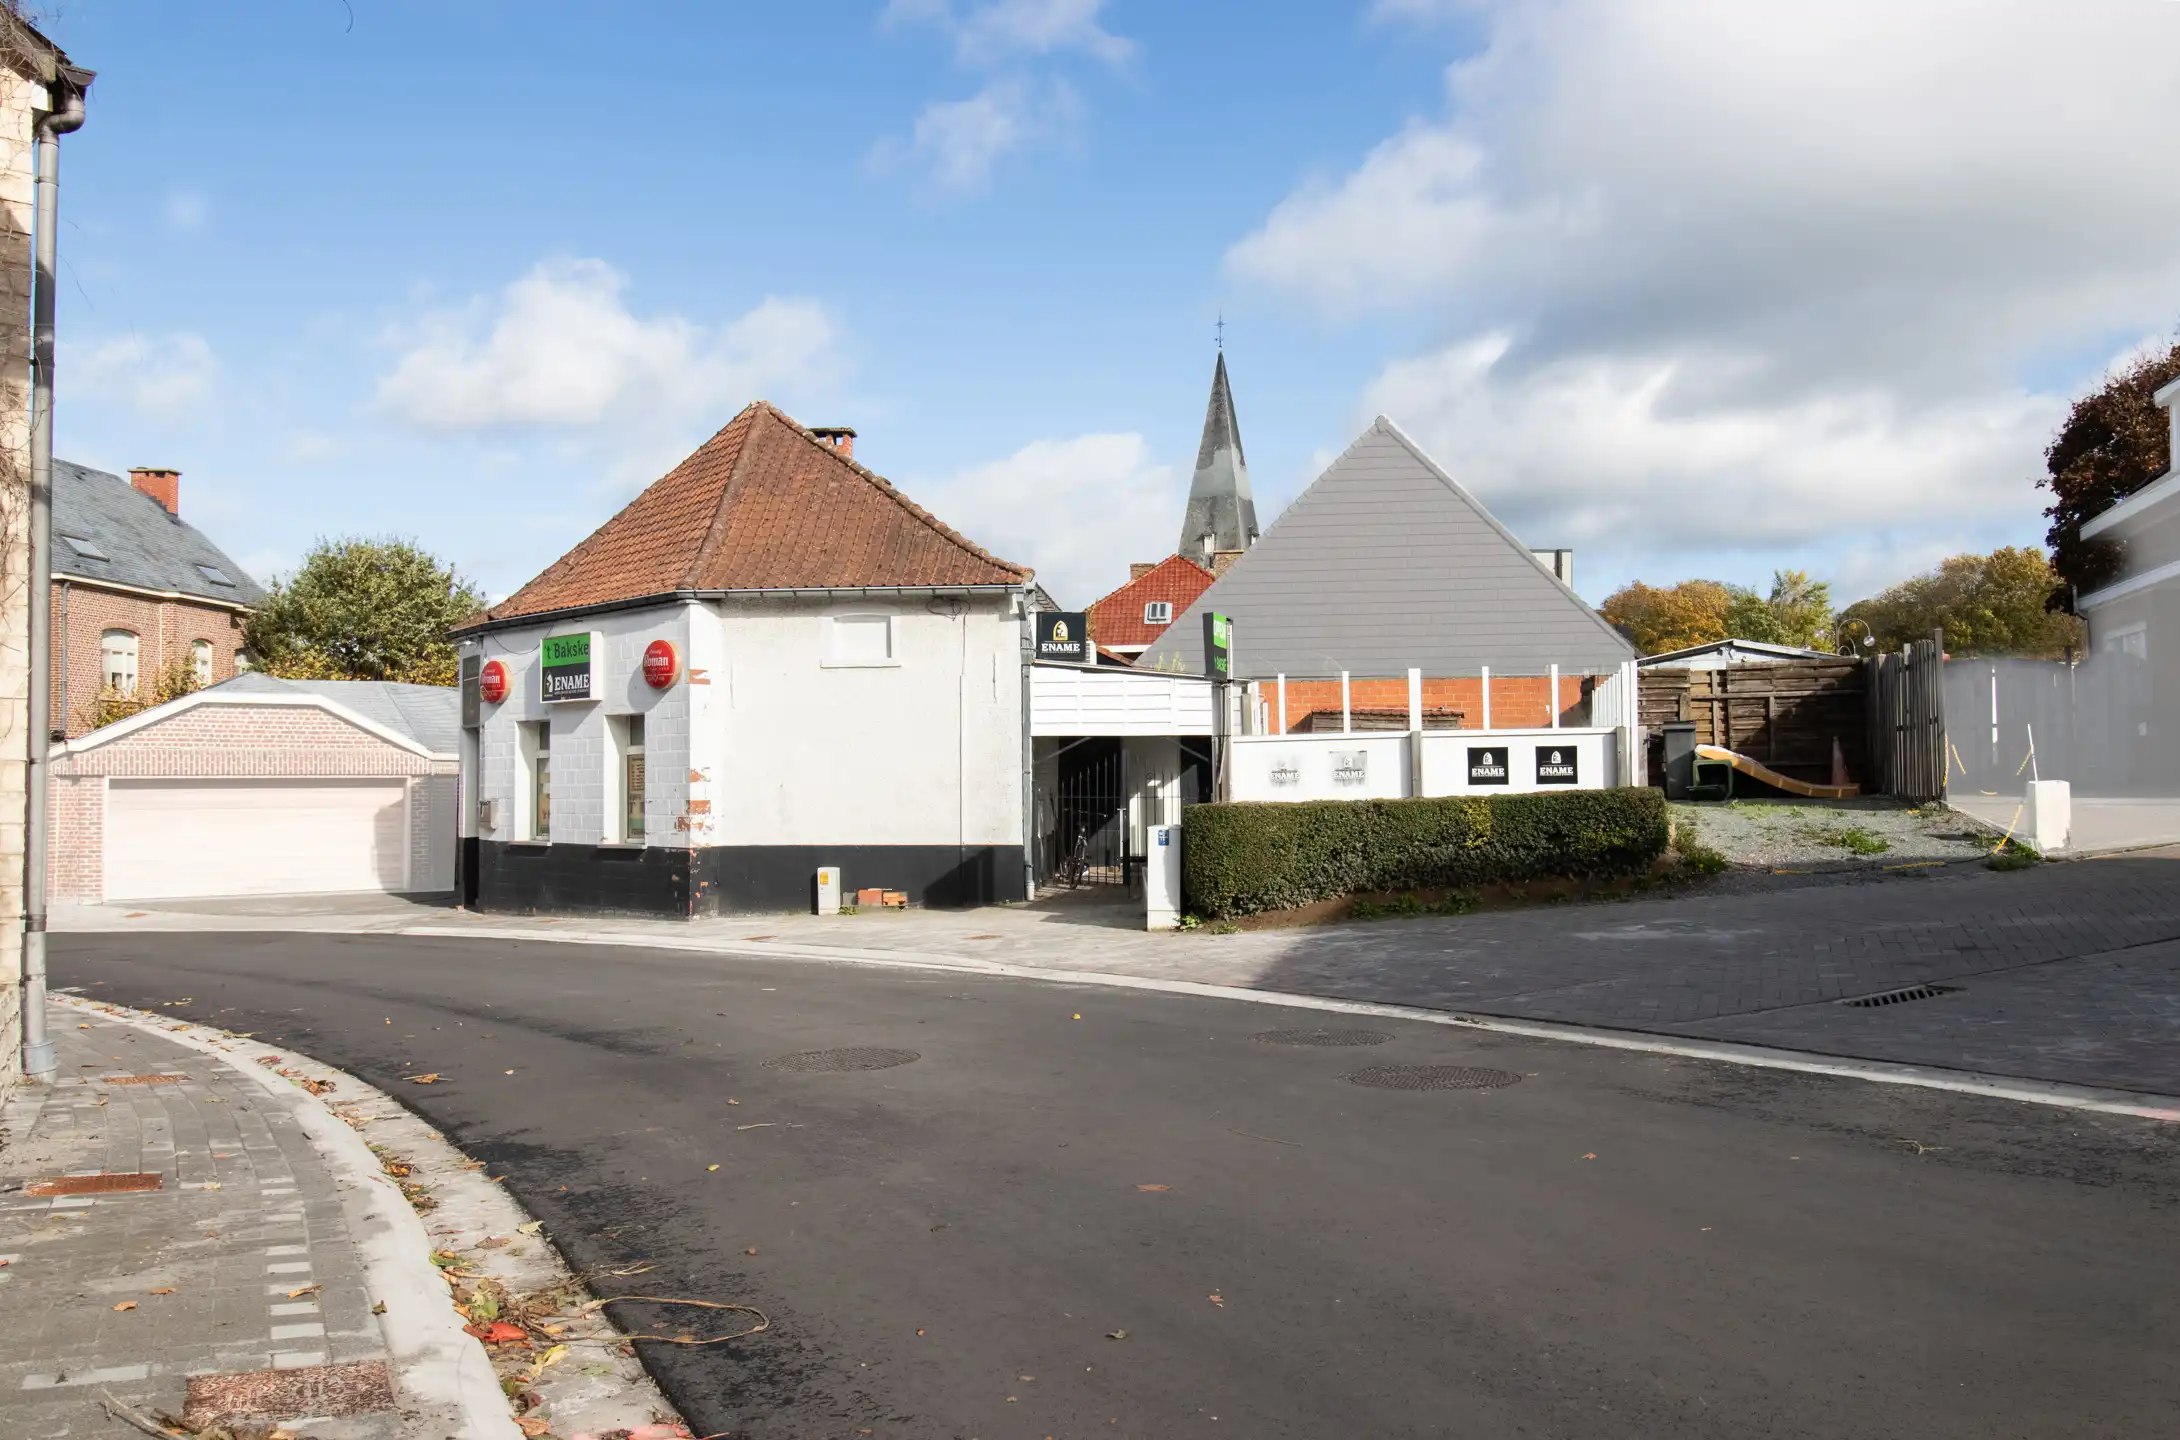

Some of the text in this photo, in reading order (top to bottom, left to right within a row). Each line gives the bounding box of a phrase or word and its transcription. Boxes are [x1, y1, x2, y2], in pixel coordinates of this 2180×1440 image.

[554, 640, 589, 659] Bakske
[1041, 643, 1080, 652] ENAME
[554, 674, 590, 691] ENAME
[1333, 770, 1366, 779] ENAME
[1471, 768, 1505, 776] ENAME
[1539, 767, 1574, 775] ENAME
